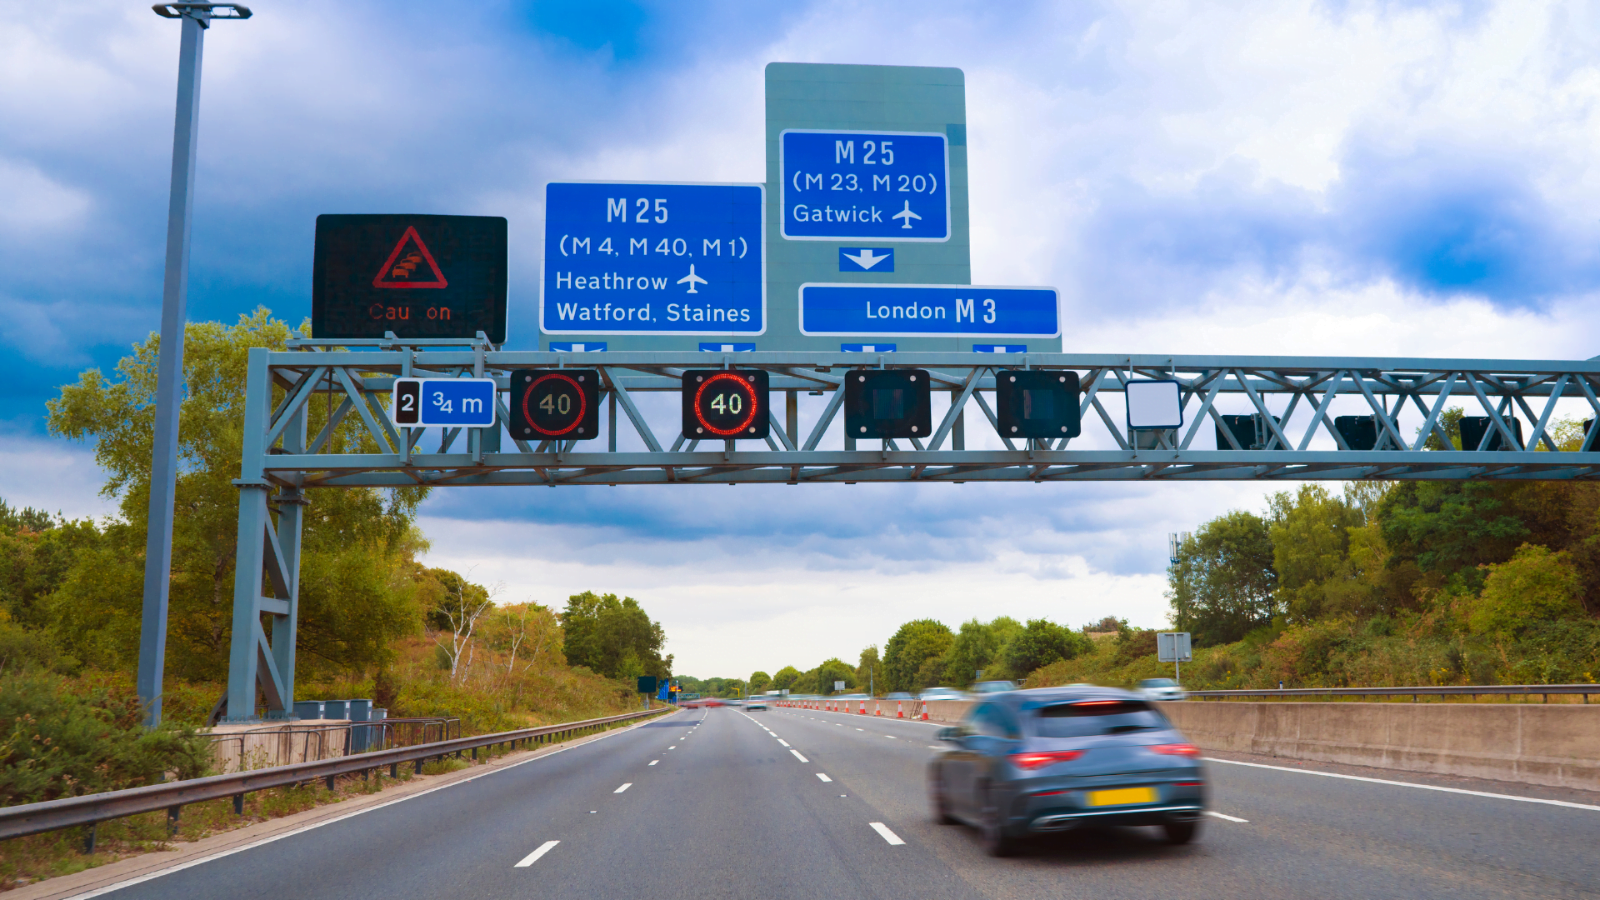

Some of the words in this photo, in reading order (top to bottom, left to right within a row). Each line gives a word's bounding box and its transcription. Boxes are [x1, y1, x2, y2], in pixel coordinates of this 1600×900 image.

[793, 203, 883, 223] Gatwick
[556, 271, 668, 290] Heathrow
[556, 302, 657, 323] Watford,
[666, 303, 751, 322] Staines
[866, 300, 946, 319] London
[401, 393, 415, 412] 2
[462, 397, 483, 414] m
[539, 393, 571, 415] 40
[710, 393, 742, 415] 40
